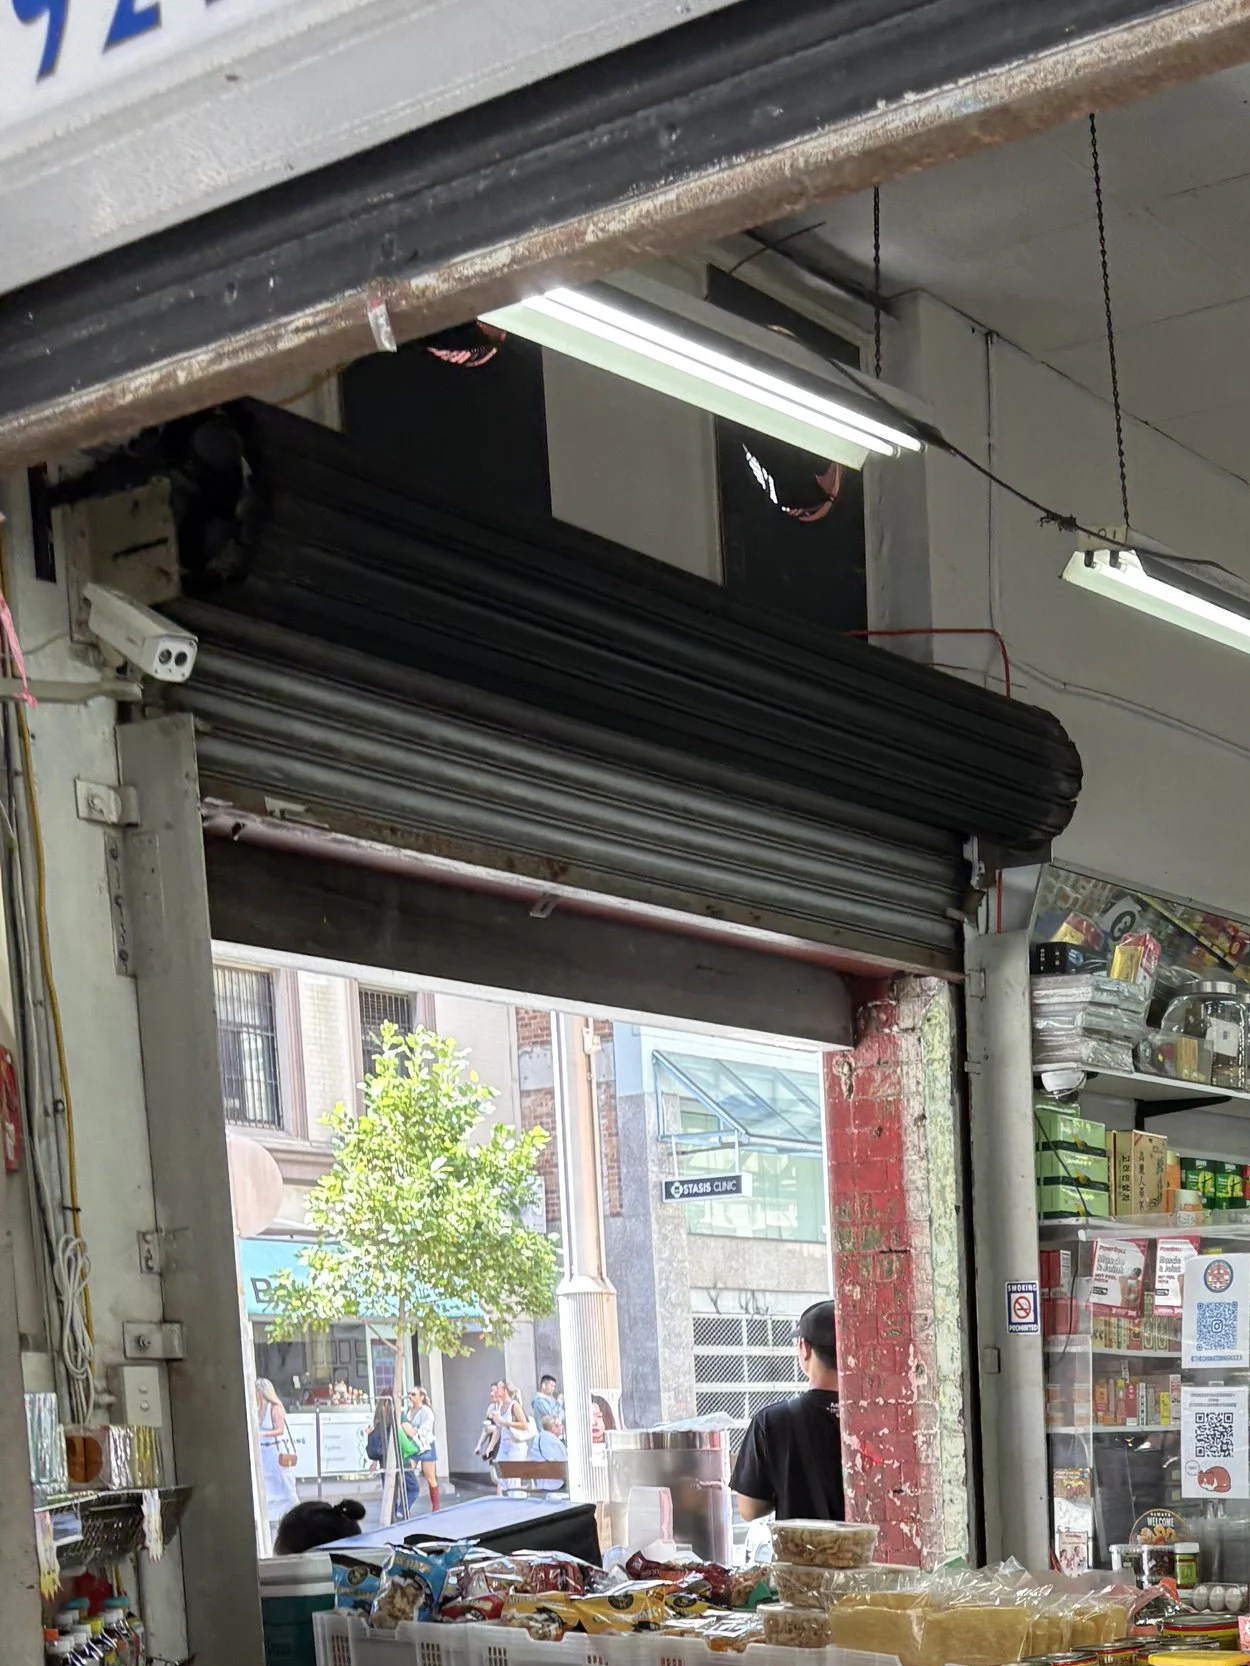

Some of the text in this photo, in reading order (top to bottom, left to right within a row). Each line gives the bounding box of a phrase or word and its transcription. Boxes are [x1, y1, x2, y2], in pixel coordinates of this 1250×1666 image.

[684, 1181, 737, 1194] STASIS CLINIC
[1007, 1283, 1037, 1292] SMOKING
[1147, 1517, 1174, 1527] WELCOME
